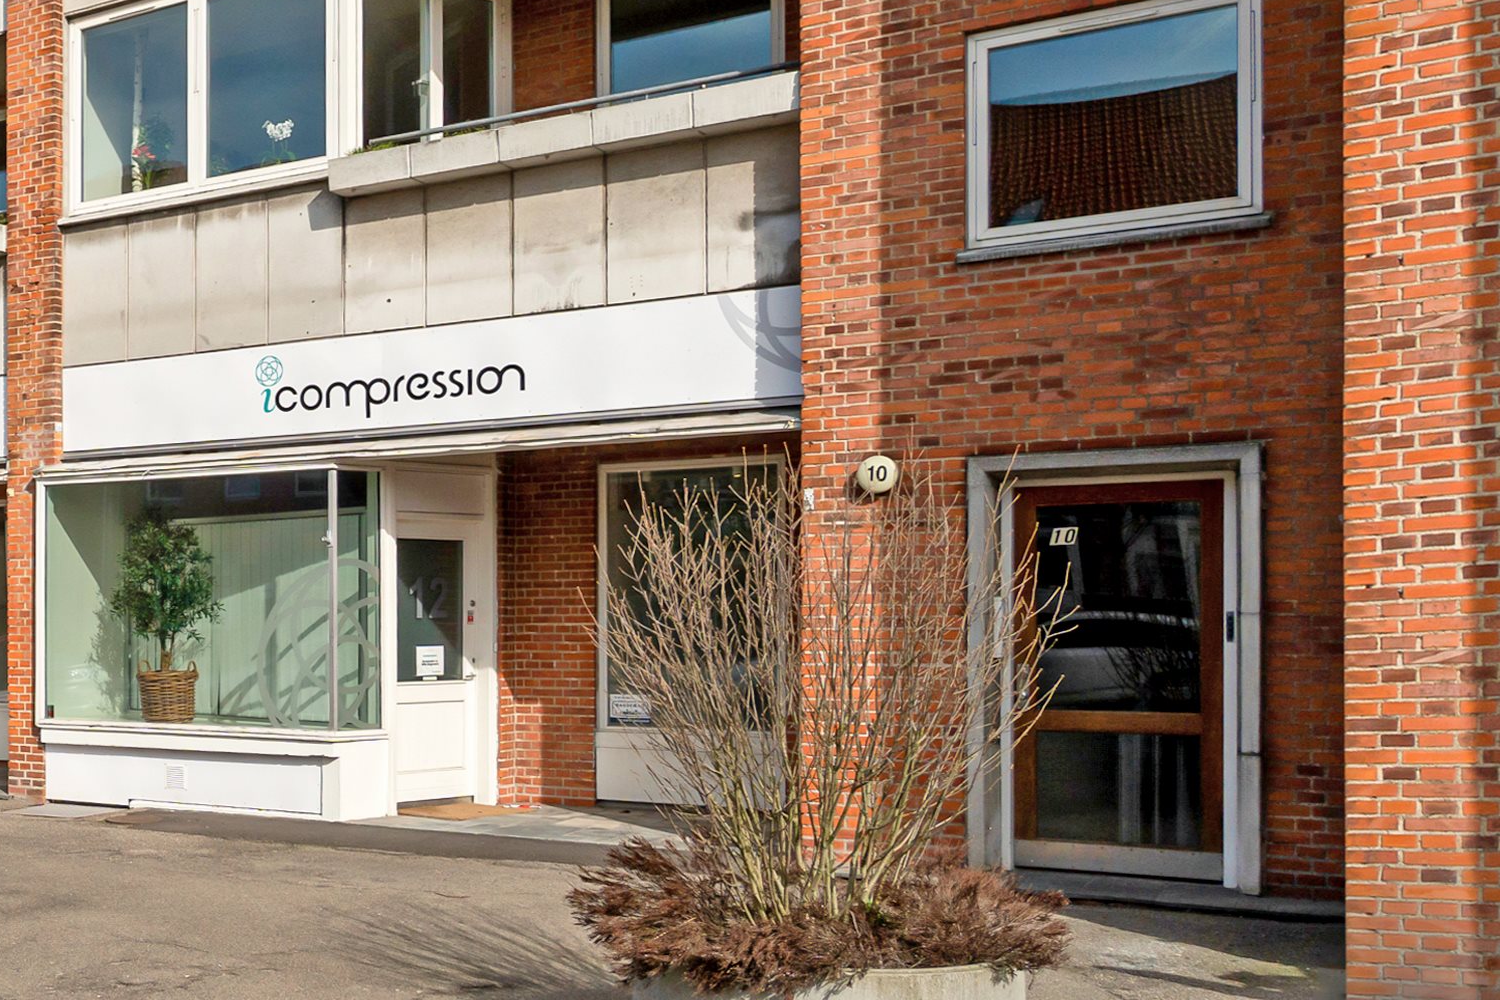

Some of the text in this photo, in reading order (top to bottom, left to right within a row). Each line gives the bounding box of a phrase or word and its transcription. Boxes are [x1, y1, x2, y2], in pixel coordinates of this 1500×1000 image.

[261, 364, 525, 418] icompression
[867, 465, 887, 482] 10
[1054, 529, 1076, 544] 10
[408, 578, 448, 619] 12
